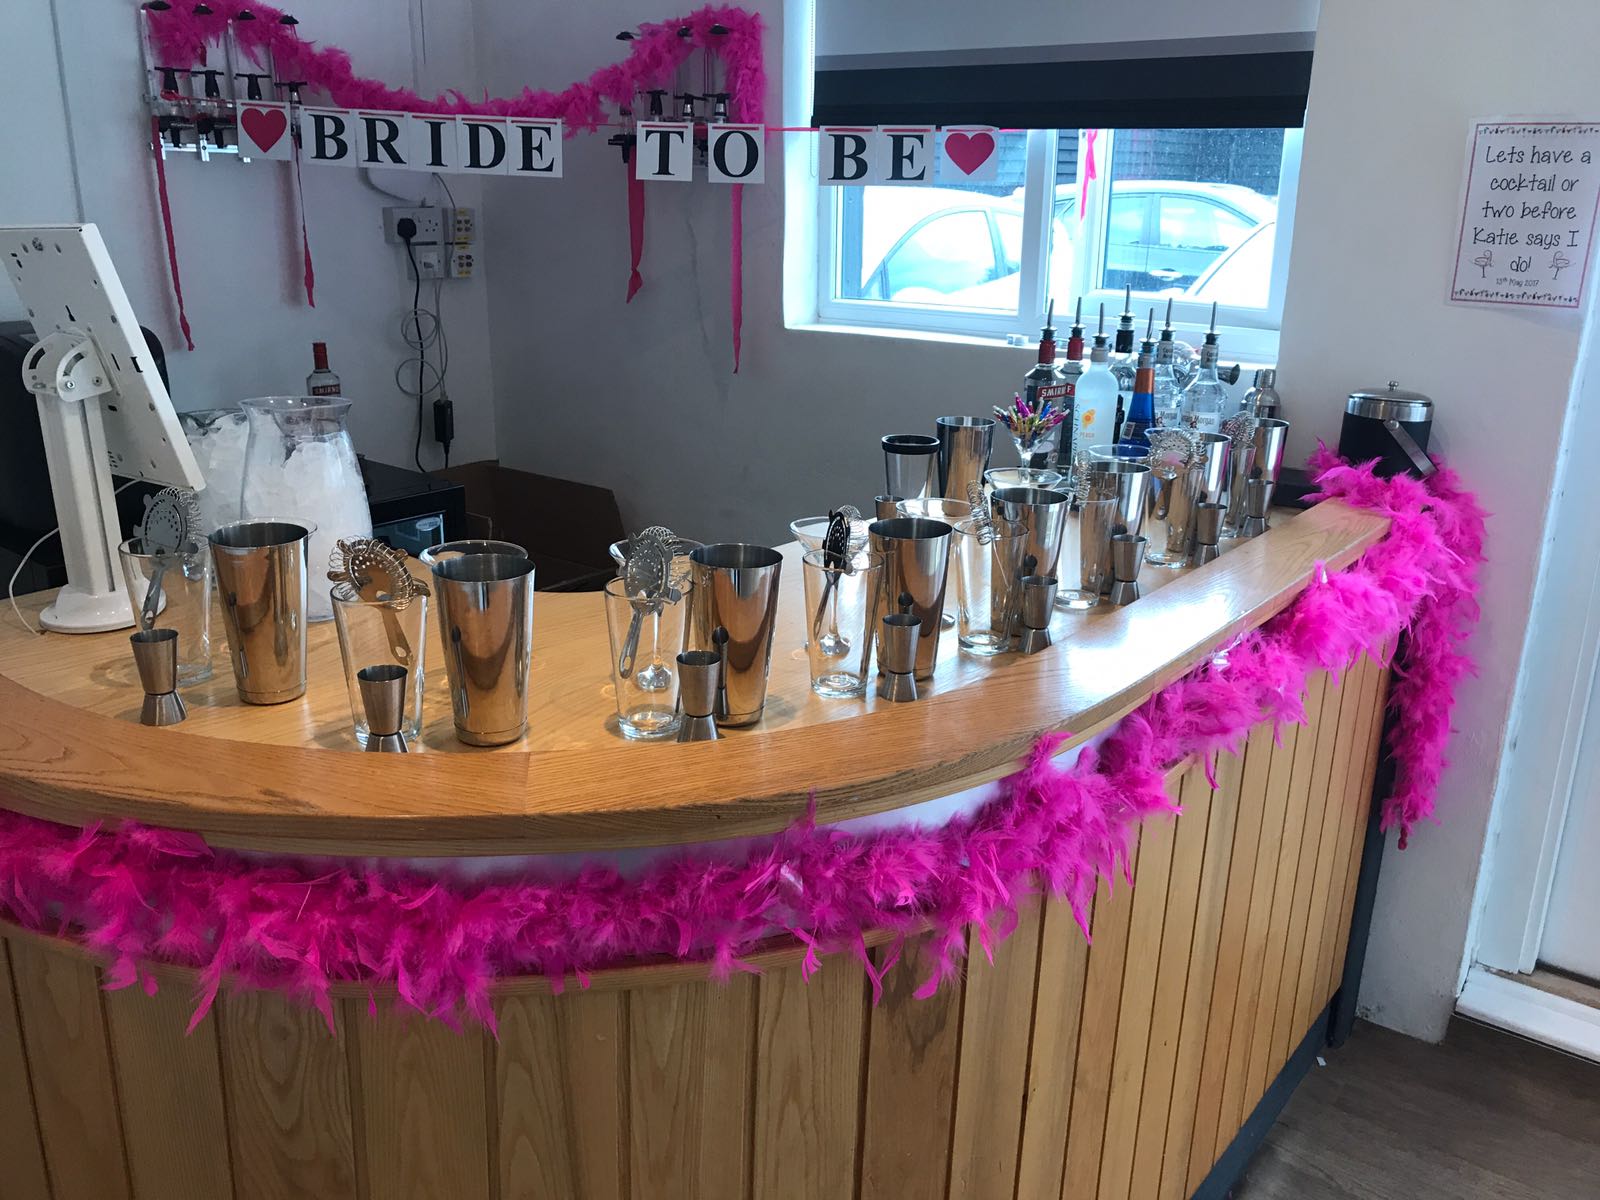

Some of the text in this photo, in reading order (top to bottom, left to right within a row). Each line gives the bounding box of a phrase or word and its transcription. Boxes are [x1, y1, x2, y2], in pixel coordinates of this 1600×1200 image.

[308, 113, 927, 182] BRIDE TO BE
[1485, 145, 1592, 164] Lets have a
[1490, 173, 1580, 192] cocktail or
[1482, 200, 1577, 220] two before
[1473, 226, 1580, 250] Katie says I
[1510, 255, 1532, 273] do!
